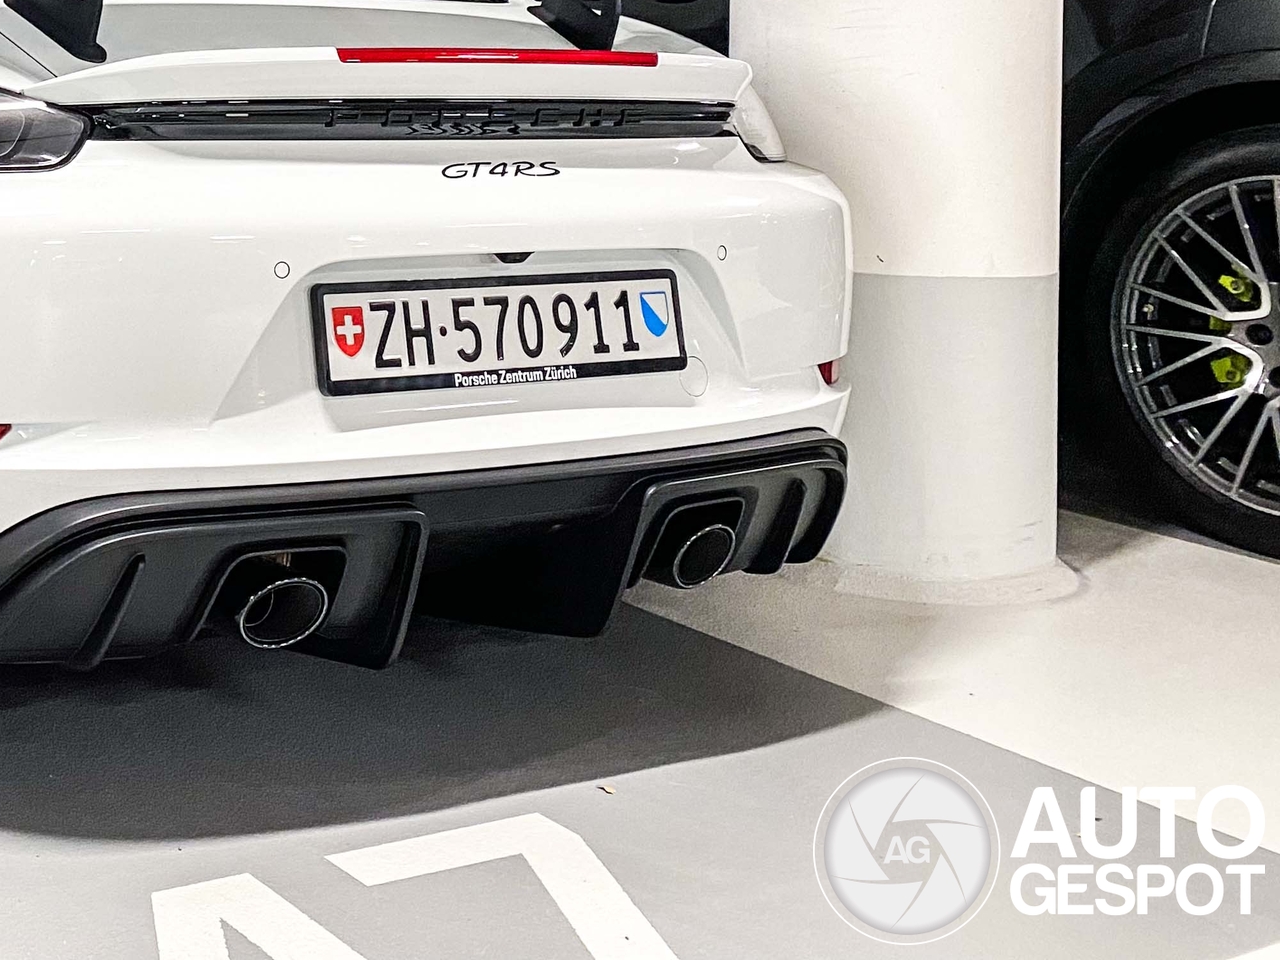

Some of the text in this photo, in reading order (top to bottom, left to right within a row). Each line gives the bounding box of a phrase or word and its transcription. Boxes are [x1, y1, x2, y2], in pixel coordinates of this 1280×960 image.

[454, 365, 577, 387] Porsche Zentrum Zürich
